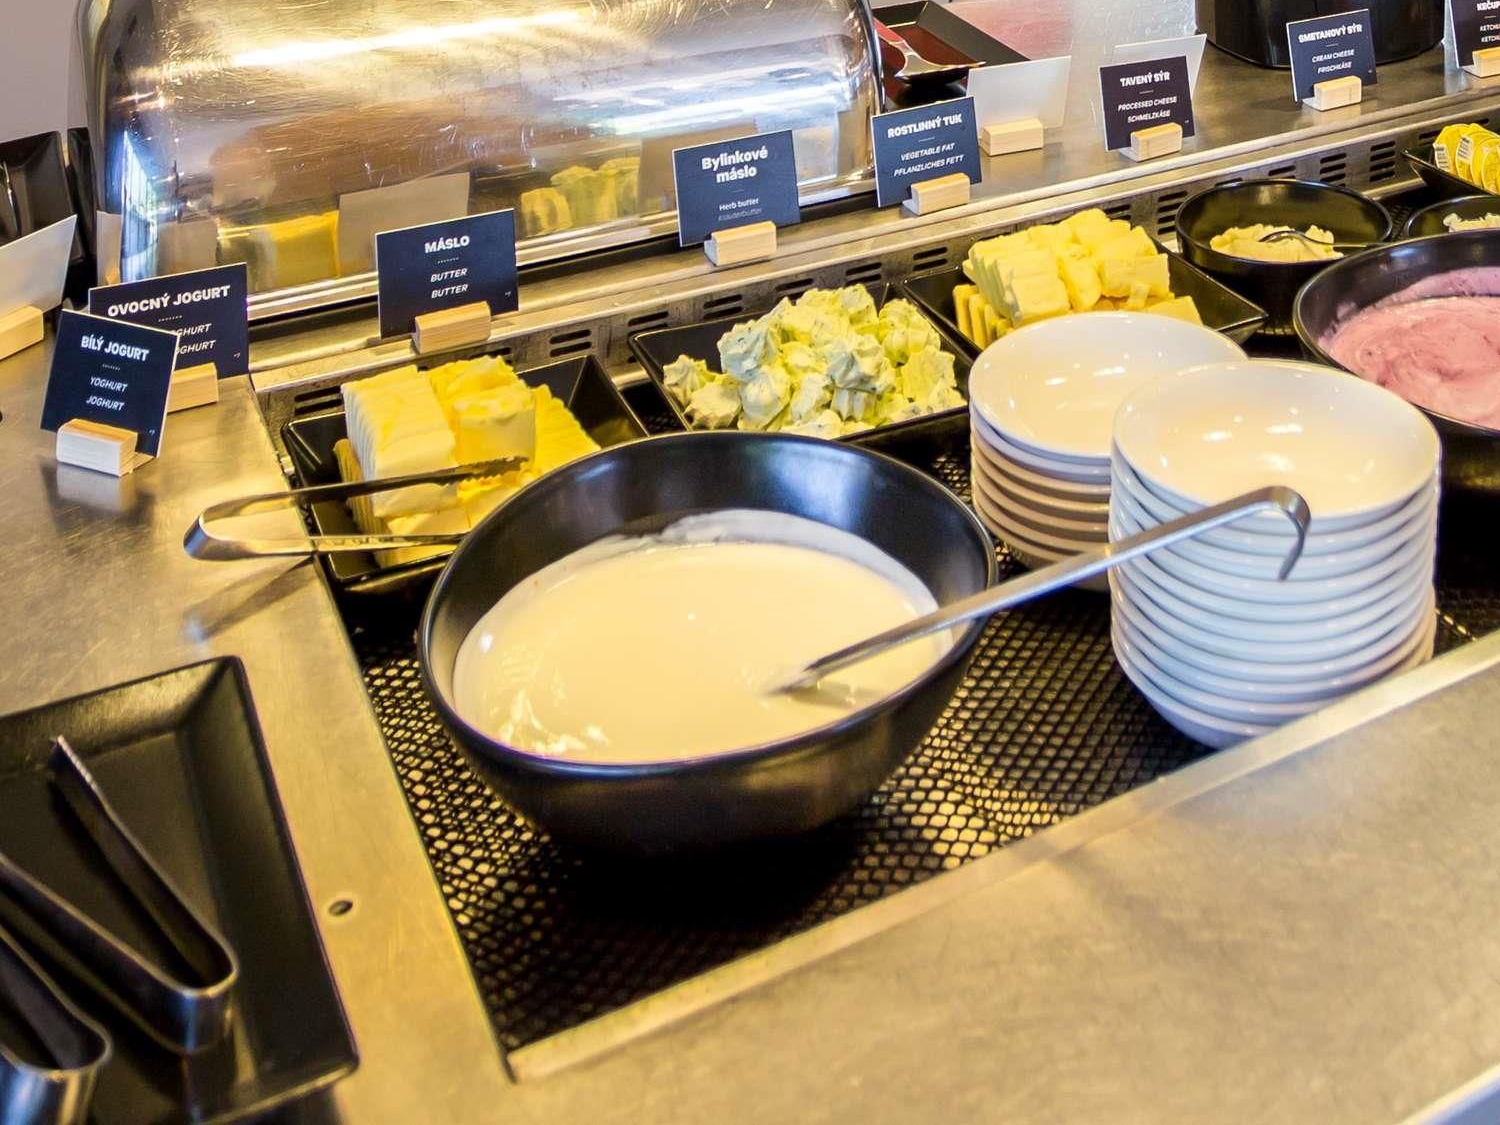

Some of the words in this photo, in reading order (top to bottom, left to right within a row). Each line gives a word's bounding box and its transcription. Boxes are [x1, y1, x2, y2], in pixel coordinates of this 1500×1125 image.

[1476, 0, 1500, 11] KEČUP
[1333, 49, 1355, 58] CHEESE
[1120, 72, 1153, 87] TAVENÝ
[1153, 69, 1170, 82] SÝR
[1117, 99, 1154, 112] PROCESSED
[1154, 96, 1178, 106] CHEESE
[887, 116, 941, 138] ROSTLINNÝ
[942, 113, 963, 126] TUK
[701, 145, 769, 171] Bylinkové
[900, 145, 941, 161] VEGETABLE
[941, 142, 955, 152] FAT
[716, 164, 758, 183] máslo
[893, 159, 946, 177] PFLANZLICHES
[945, 154, 964, 165] FETT
[719, 201, 737, 211] Herb
[737, 198, 759, 208] butter
[424, 235, 470, 254] MÁSLO
[430, 267, 468, 282] BUTTER
[431, 284, 469, 298] BUTTER
[107, 292, 171, 317] OVOCNÝ
[172, 285, 231, 305] JOGURT
[80, 334, 105, 351] BÍLÝ
[104, 341, 150, 361] JOGURT
[90, 376, 128, 392] YOGHURT
[86, 395, 125, 411] JOGHURT
